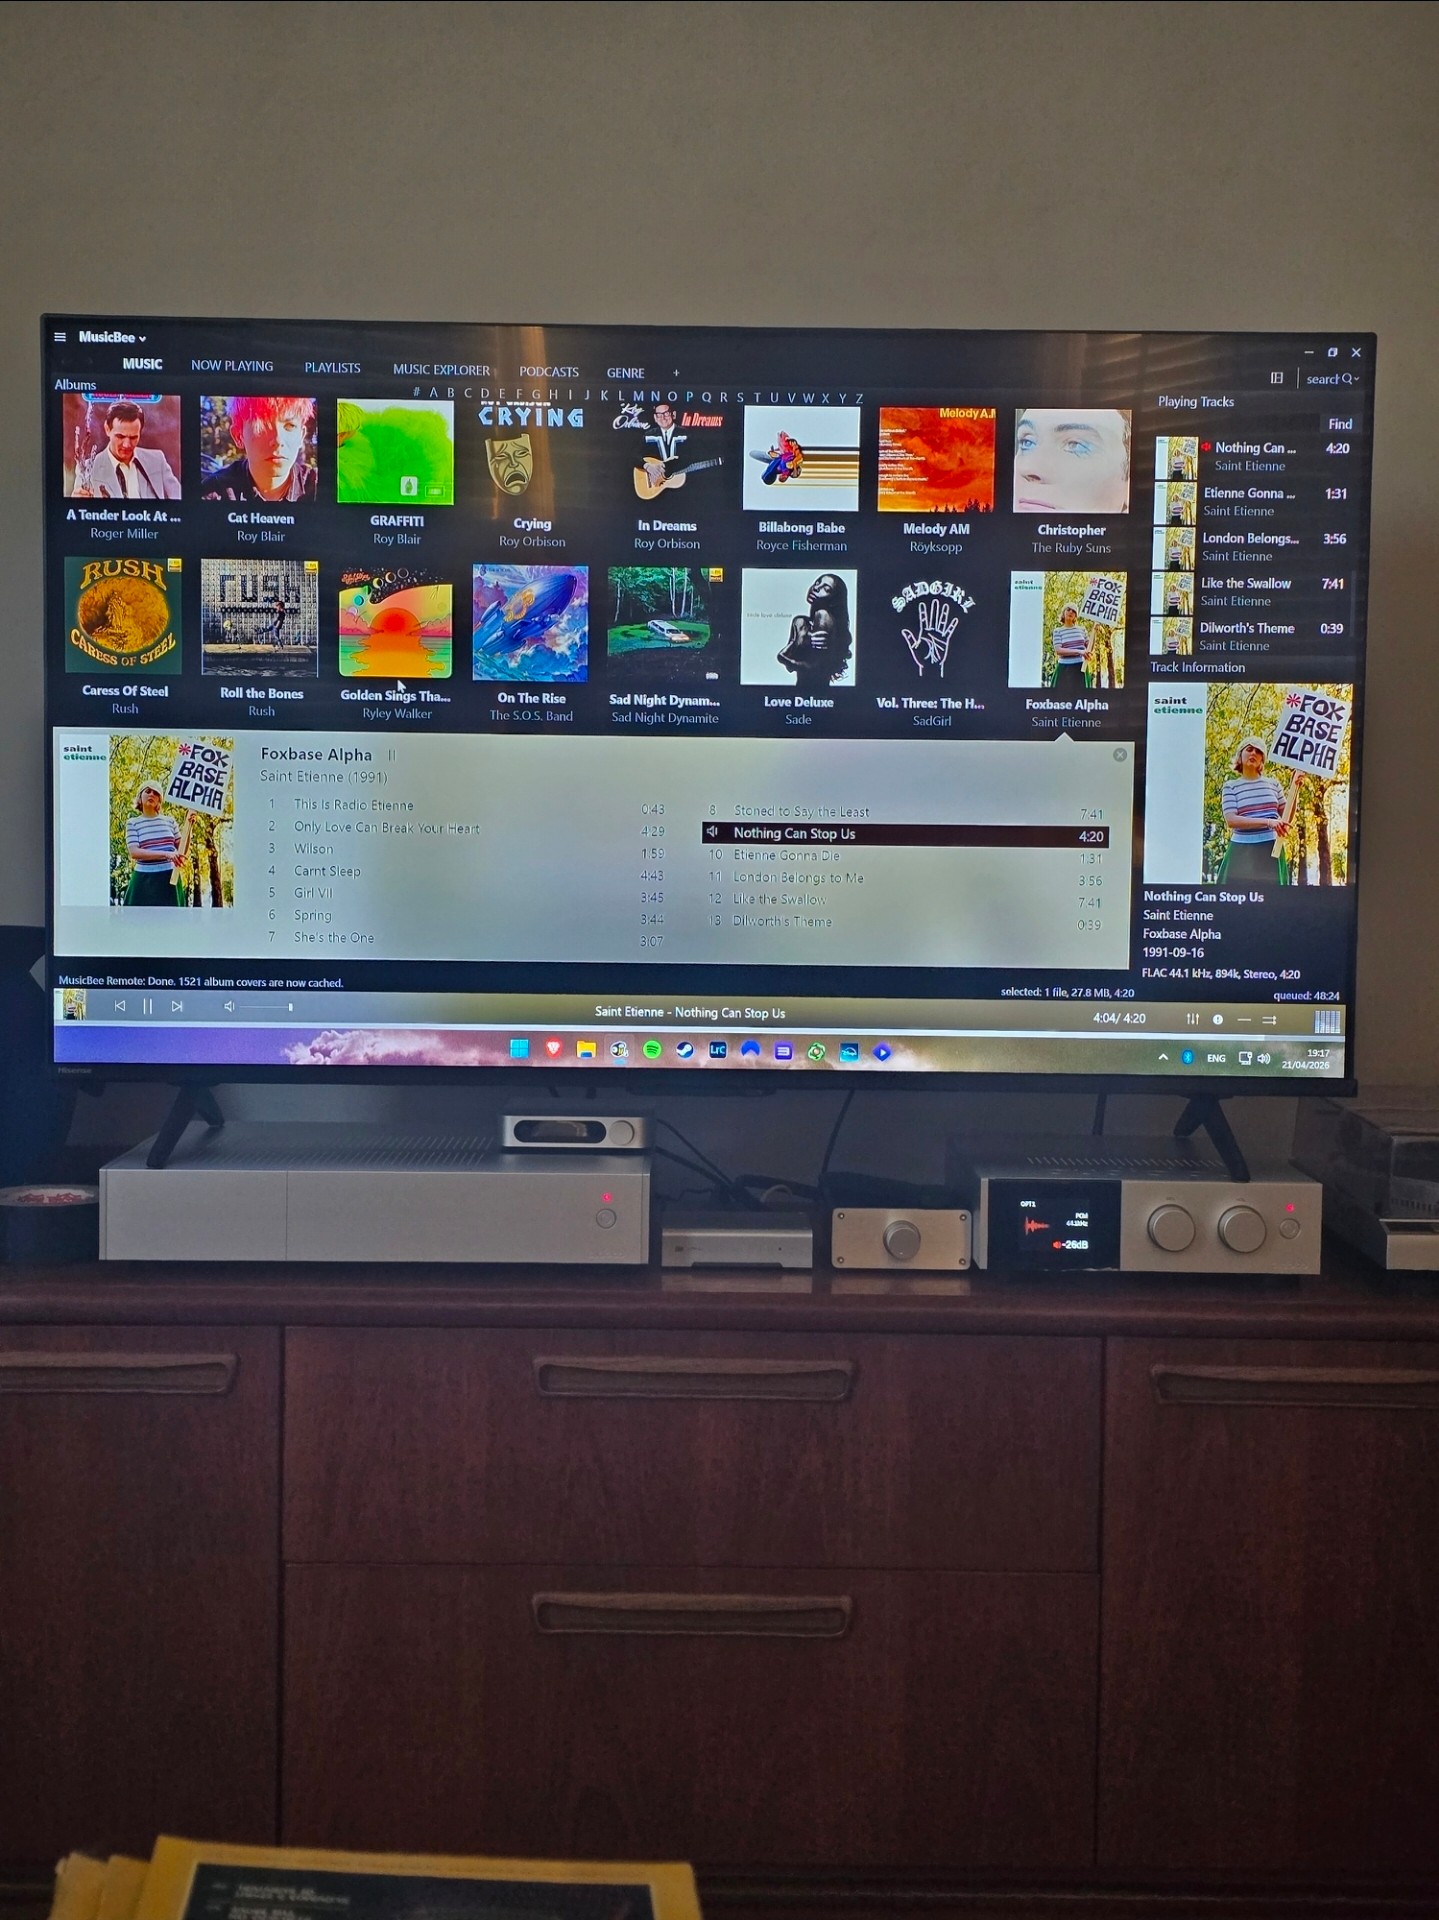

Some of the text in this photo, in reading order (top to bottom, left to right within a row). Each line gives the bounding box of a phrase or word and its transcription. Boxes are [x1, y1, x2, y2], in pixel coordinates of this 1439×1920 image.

[80, 331, 135, 343] MusicBee
[124, 358, 162, 369] MUSIC
[192, 360, 273, 371] NOW PLAYING
[306, 362, 360, 373] PLAYLISTS
[394, 364, 490, 376] MUSIC EXPLORER
[520, 366, 579, 377] PODCASTS
[607, 368, 644, 378] GENRE
[55, 379, 96, 390] Albums
[1159, 396, 1234, 409] Playing Tracks
[479, 406, 584, 428] CRYING
[681, 412, 723, 428] In Dreams
[1330, 418, 1352, 429] Find
[1216, 442, 1284, 455] Nothing Can
[1326, 443, 1350, 454] 4:20
[1205, 487, 1284, 498] Etienne Gonna
[1326, 488, 1346, 499] 1:31
[67, 509, 167, 521] A Tender Look At
[228, 513, 294, 524] Cat Heaven
[371, 516, 424, 526] GRAFFITI
[514, 518, 551, 531] Crying
[639, 520, 697, 531] In Dreams
[91, 528, 158, 540] Roger Miller
[759, 522, 845, 535] Billabong Babe
[904, 523, 969, 537] Melody AM
[1038, 524, 1106, 538] Christopher
[238, 531, 285, 543] Roy Blair
[500, 536, 565, 548] Roy Orbison
[1204, 532, 1244, 544] London
[1324, 534, 1346, 544] 3:56
[757, 540, 847, 552] Royce Fisherman
[911, 542, 962, 554] Röyksopp
[1032, 542, 1111, 555] The Ruby Suns
[79, 559, 168, 591] RUSH
[1202, 578, 1291, 589] Like the Swallow
[1322, 578, 1343, 589] 7:41
[1200, 622, 1295, 633] Dilworth's Theme
[1321, 624, 1343, 634] 0:39
[70, 628, 177, 666] CARESS OF STEEL
[1151, 662, 1245, 672] Track Information
[83, 685, 168, 696] Caress Of Steel
[221, 688, 304, 699] Roll the Bones
[341, 690, 382, 700] Golden
[385, 692, 416, 703] Sings
[498, 692, 566, 703] On The Rise
[610, 694, 630, 704] Sad
[634, 694, 666, 707] Night
[765, 696, 834, 707] Love Deluxe
[1154, 696, 1187, 705] saint
[876, 697, 898, 708] Vol.
[902, 698, 937, 708] Three:
[940, 698, 962, 708] The
[1026, 699, 1108, 712] Foxbase Alpha
[1299, 694, 1345, 722] FOX
[113, 704, 138, 713] Rush
[364, 708, 432, 720] Ryley Walker
[1154, 706, 1203, 715] etienne
[490, 710, 572, 721] The S.O.S. Band
[612, 712, 718, 725] Sad Night Dynamite
[786, 714, 812, 724] Sade
[914, 716, 951, 726] SadGirl
[1032, 717, 1101, 727] Saint Etienne
[1285, 714, 1342, 744] BASE
[262, 747, 371, 764] Foxbase Alpha
[1272, 732, 1337, 771] ALPHA
[295, 843, 333, 854] Wilson
[1144, 891, 1264, 904] Nothing Can Stop Us
[295, 909, 331, 923] Spring
[1144, 947, 1204, 958] 1991-09-16
[1142, 968, 1300, 980] FLAC 44.1 kHz, 894k, Stereo, 4:20
[59, 976, 104, 986] MusicBee
[107, 976, 145, 985] Remote:
[148, 977, 176, 986] Done.
[179, 977, 200, 986] 1521
[204, 977, 234, 986] album
[308, 978, 343, 987] cached.
[1274, 991, 1339, 1002] queued: 48:24
[595, 1006, 622, 1016] Saint
[625, 1006, 664, 1016] Etienne
[676, 1007, 718, 1020] Nothing
[722, 1008, 741, 1018] Can
[745, 1008, 768, 1020] Stop
[773, 1008, 785, 1018] Us
[1094, 1013, 1146, 1024] 4:04/ 4:20
[1208, 1054, 1226, 1062] ENG
[1308, 1049, 1330, 1058] 19:17
[1282, 1061, 1330, 1069] 21/04/2026
[1062, 1240, 1088, 1249] -26dB
